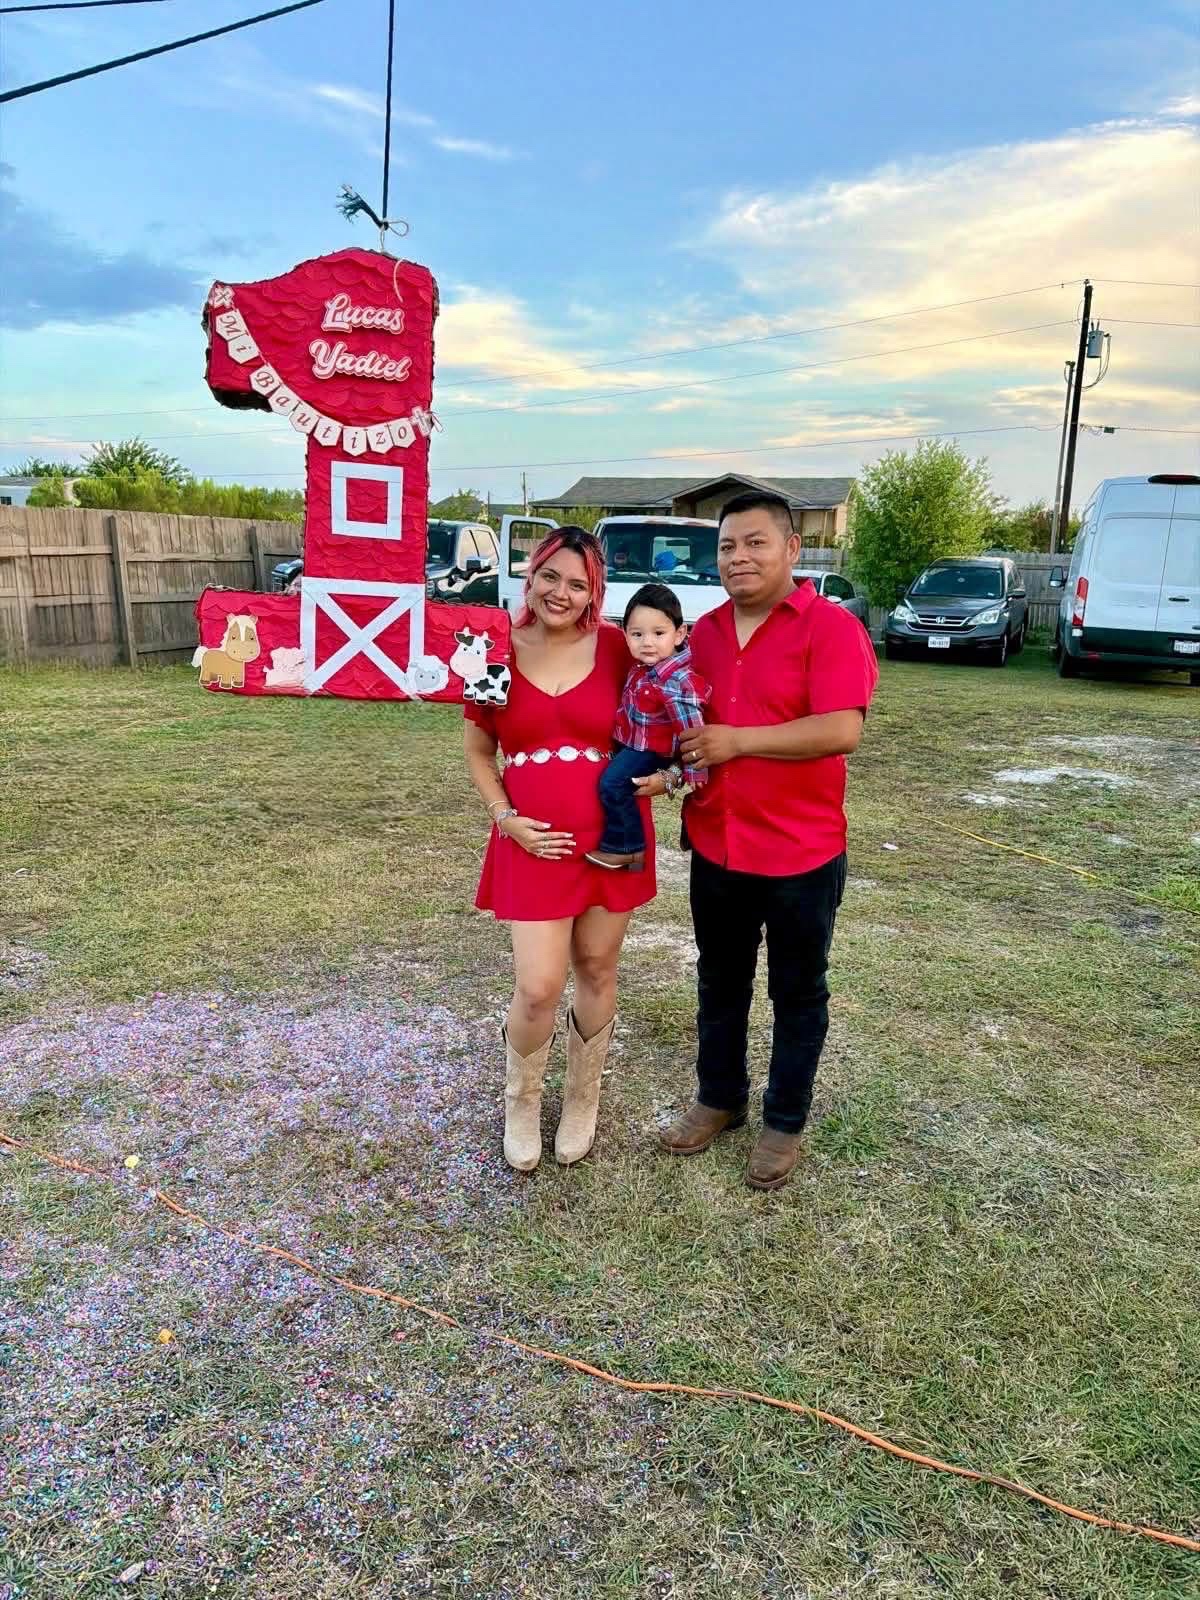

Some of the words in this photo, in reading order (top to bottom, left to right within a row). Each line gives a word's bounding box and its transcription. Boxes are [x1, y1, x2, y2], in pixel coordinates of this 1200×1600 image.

[321, 293, 404, 334] Lucas
[219, 314, 252, 353] Mi
[254, 370, 408, 449] Bautizo
[309, 339, 412, 382] Yadiel
